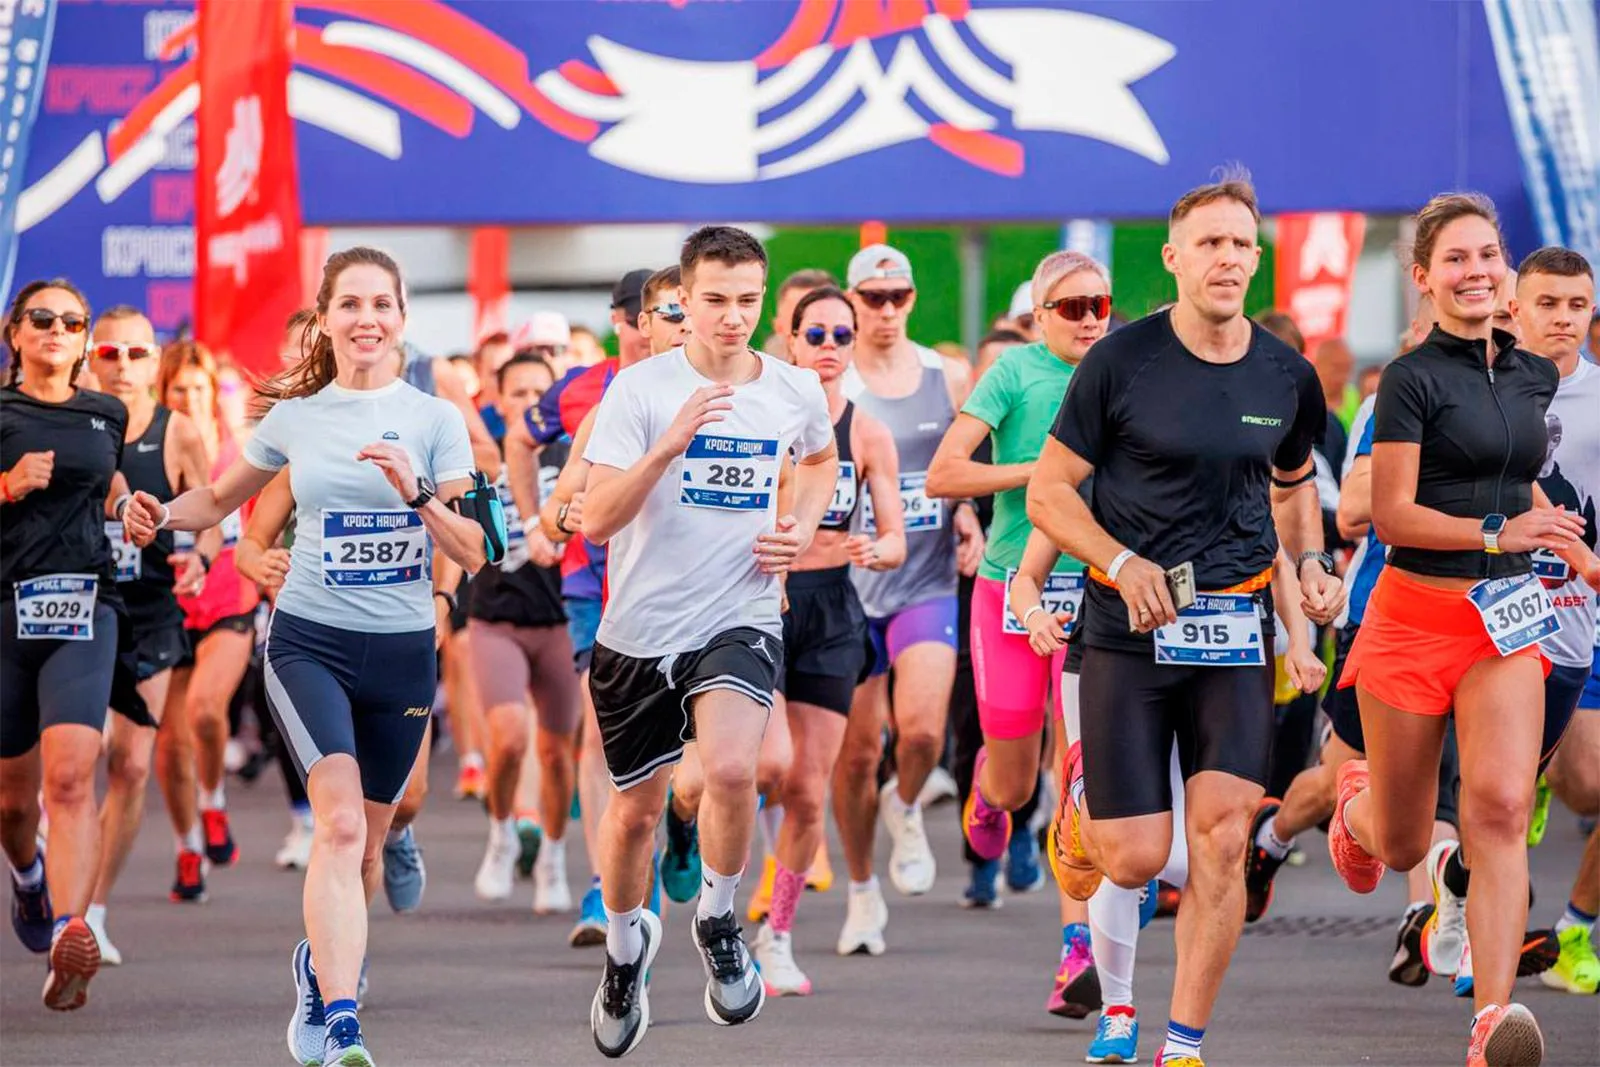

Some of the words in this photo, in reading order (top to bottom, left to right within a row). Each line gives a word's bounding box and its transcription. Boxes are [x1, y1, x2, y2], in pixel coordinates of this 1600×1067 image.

[704, 438, 735, 453] КРОСС
[707, 464, 755, 488] 282
[343, 514, 375, 528] КРОСС
[376, 514, 409, 529] НАЦИИ
[340, 541, 410, 564] 2587
[31, 600, 81, 618] 3029
[1207, 598, 1236, 611] НАЦИИ
[1494, 592, 1543, 630] 3067
[1182, 623, 1230, 645] 915
[403, 706, 429, 717] FILA
